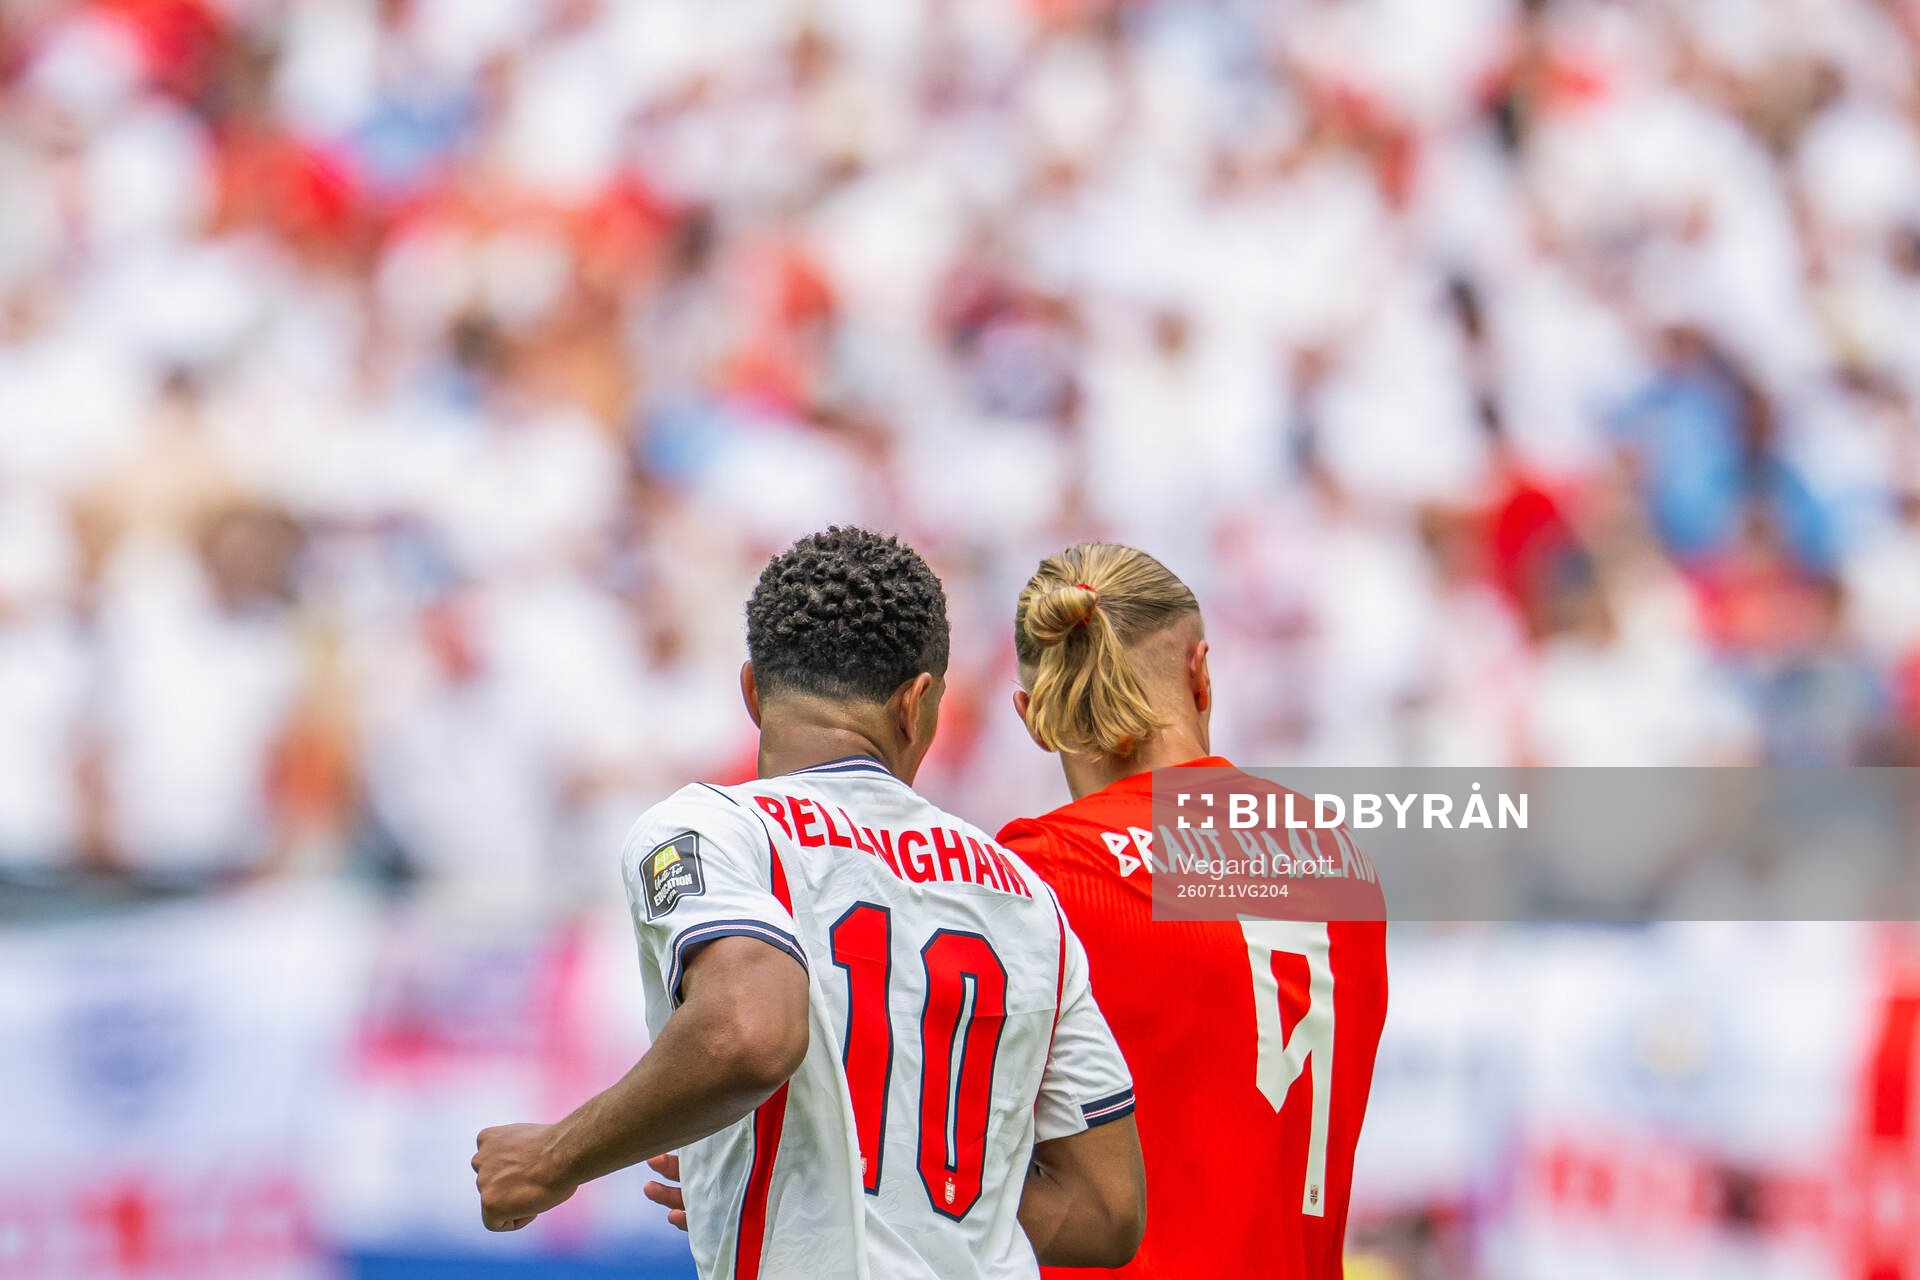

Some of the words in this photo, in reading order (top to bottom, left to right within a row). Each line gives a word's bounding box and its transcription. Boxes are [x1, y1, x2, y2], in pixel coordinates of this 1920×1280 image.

[654, 874, 692, 906] EDUCATION
[1100, 825, 1227, 878] BRAUT
[829, 900, 1008, 1223] 10
[1236, 913, 1336, 1217] 9
